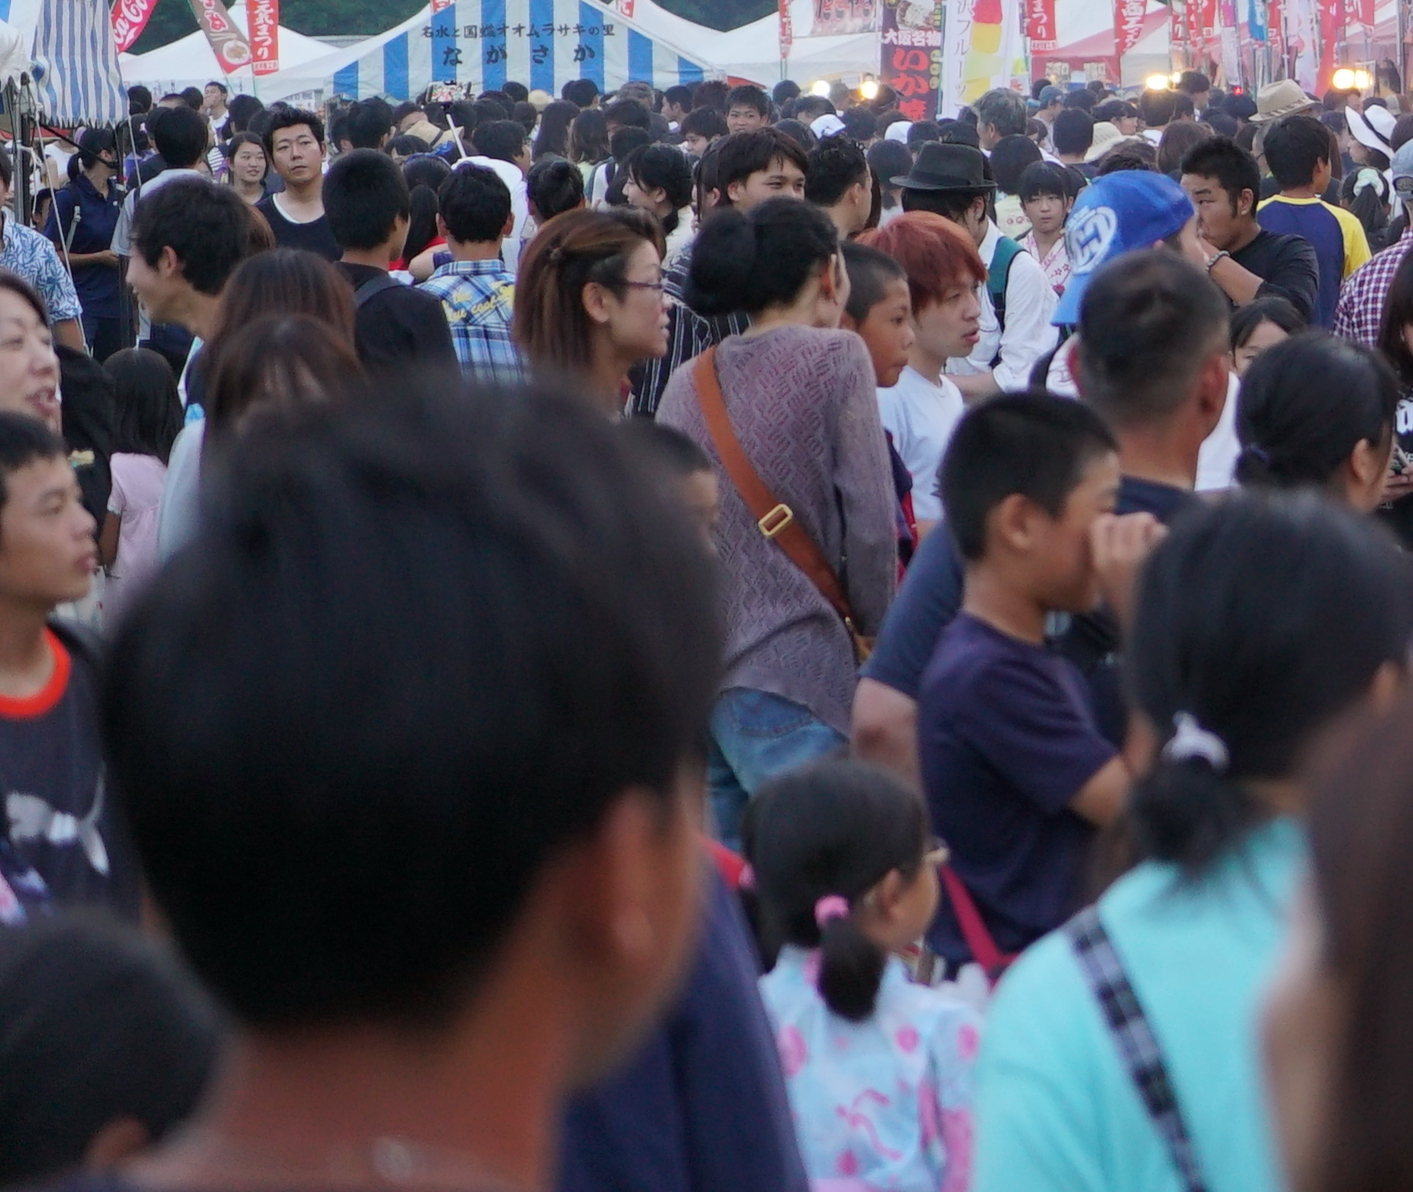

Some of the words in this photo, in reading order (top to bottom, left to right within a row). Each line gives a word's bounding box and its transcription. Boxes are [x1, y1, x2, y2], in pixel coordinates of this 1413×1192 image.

[884, 27, 942, 47] 大阪名物
[443, 43, 596, 66] ながさか
